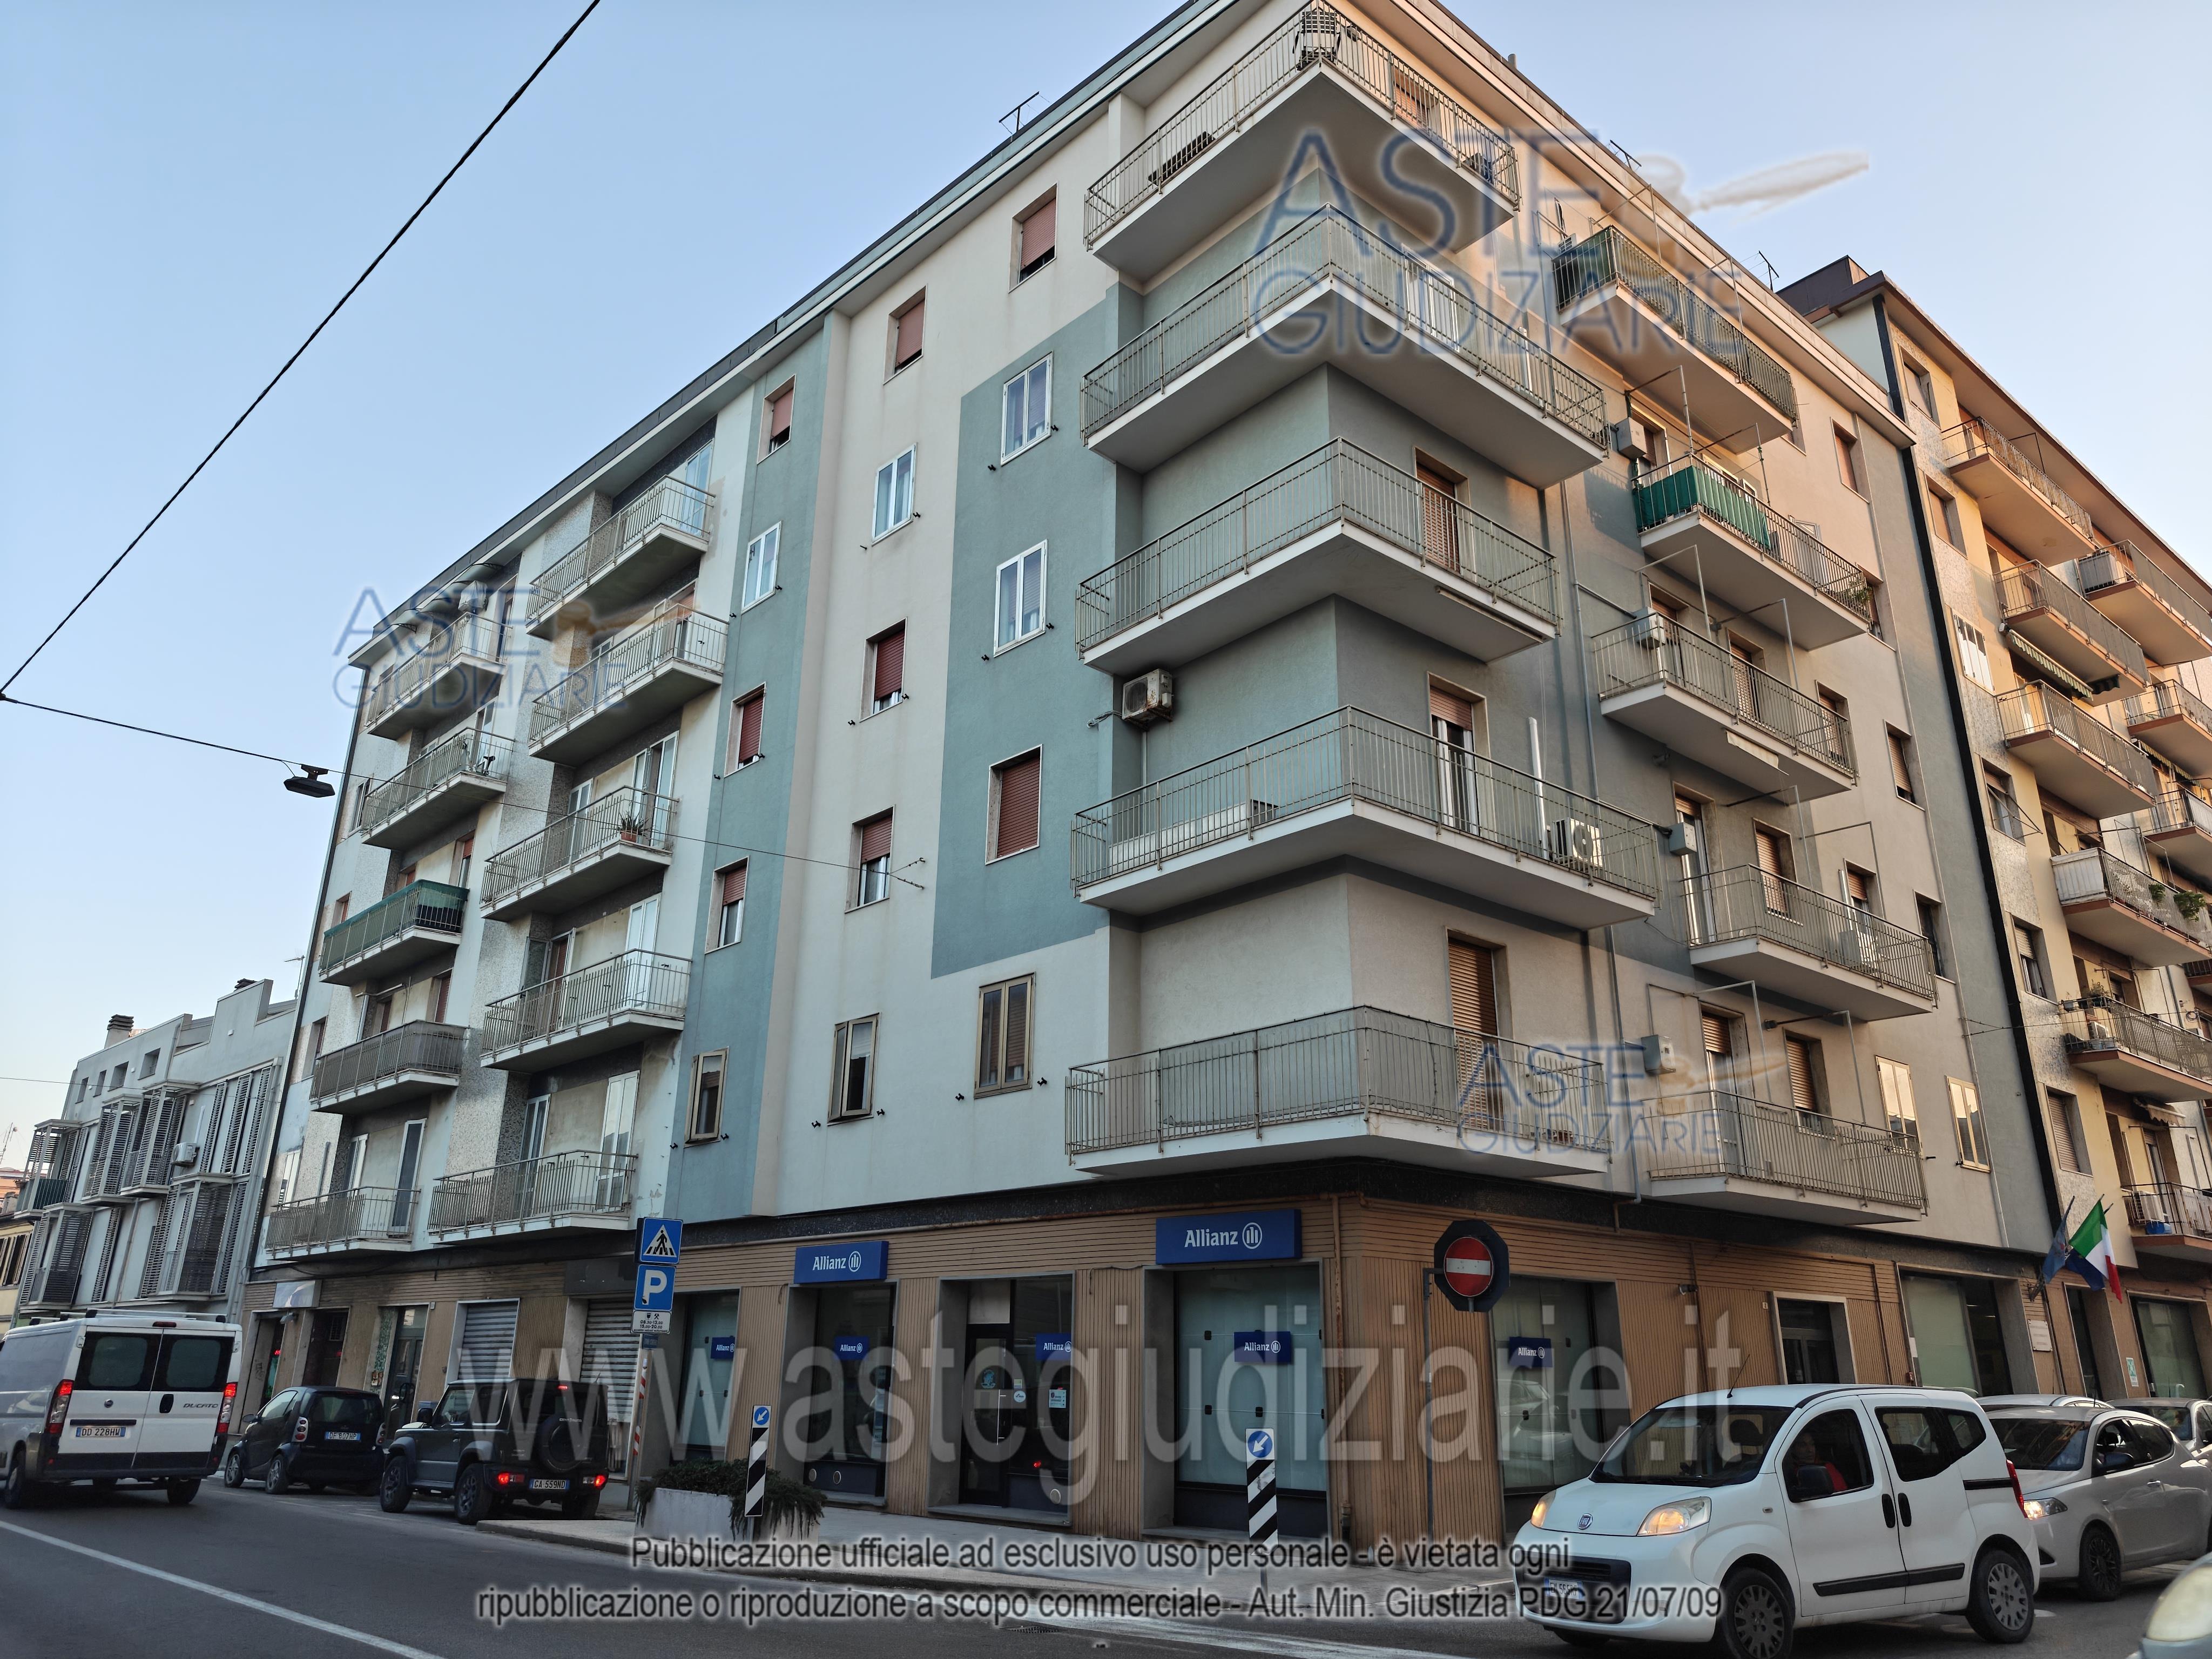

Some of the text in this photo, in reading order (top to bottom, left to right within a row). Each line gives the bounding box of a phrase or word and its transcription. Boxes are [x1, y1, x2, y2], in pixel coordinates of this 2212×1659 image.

[1184, 1229, 1238, 1247] Allianz
[812, 1256, 846, 1271] Allianz
[642, 1269, 667, 1305] P
[1043, 1343, 1064, 1351] Allianz
[1244, 1342, 1270, 1351] Allianz
[1518, 1347, 1537, 1356] Allianz
[545, 1480, 565, 1489] 559ND
